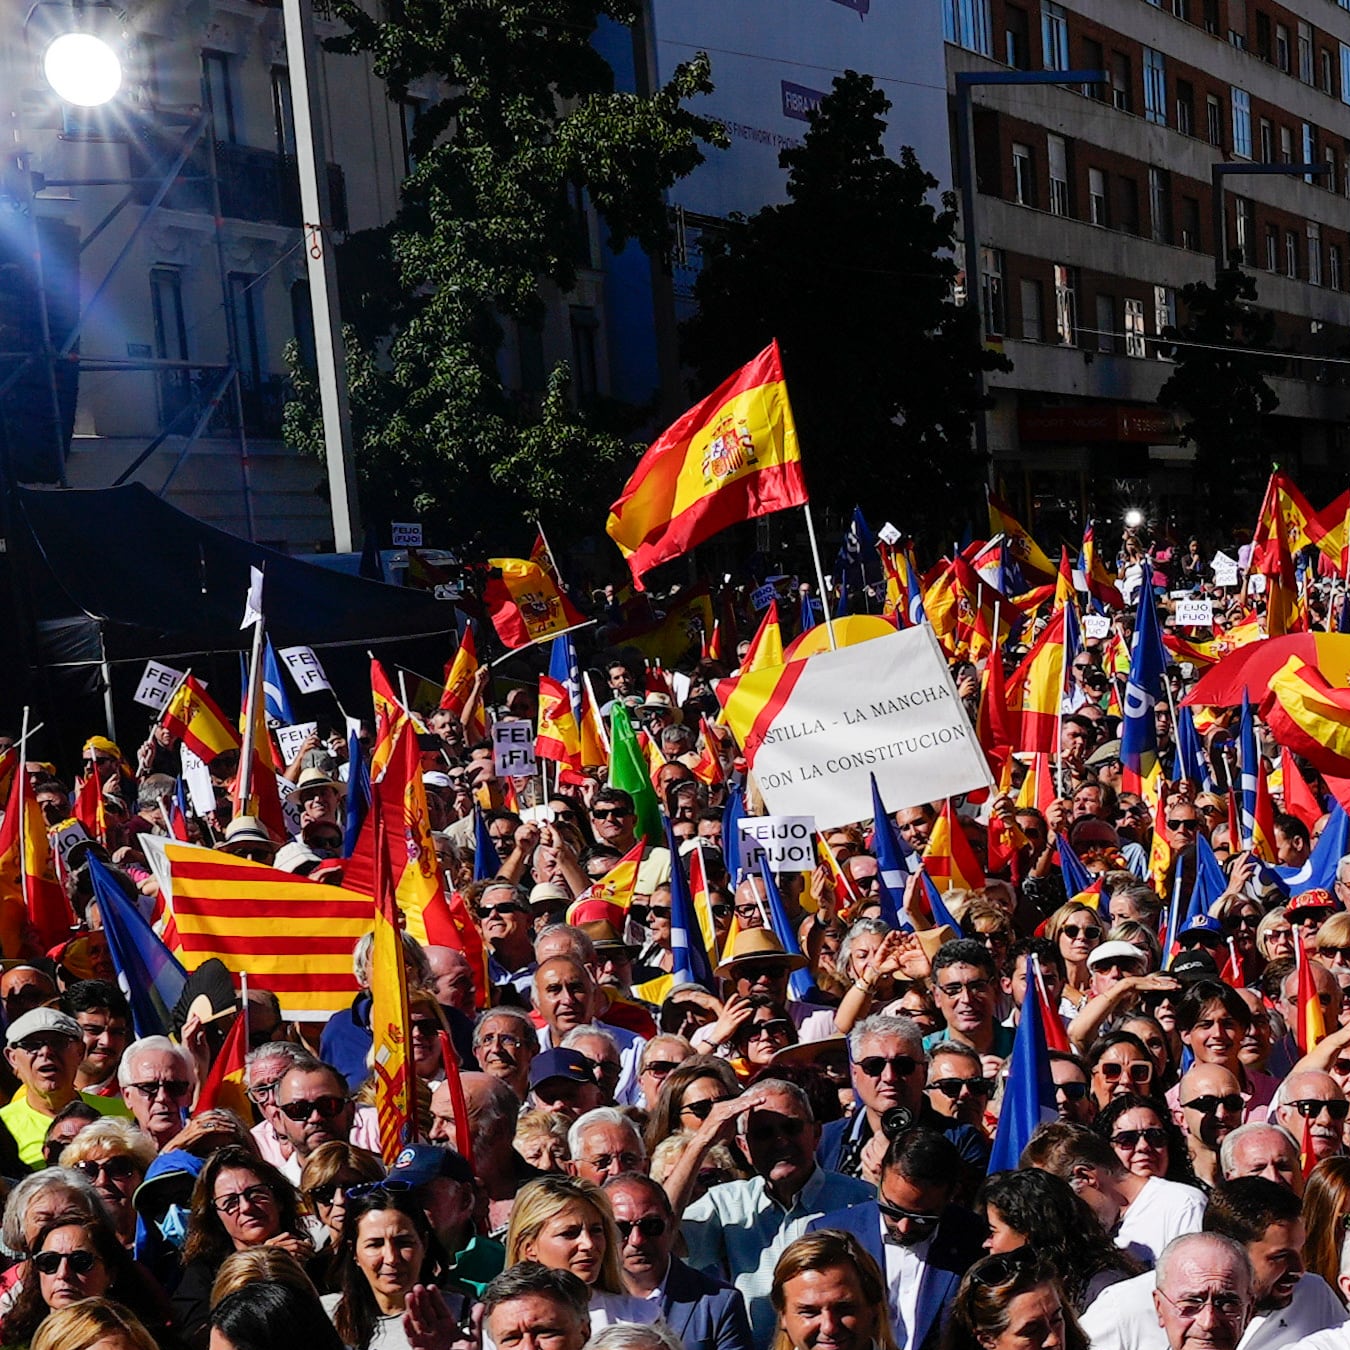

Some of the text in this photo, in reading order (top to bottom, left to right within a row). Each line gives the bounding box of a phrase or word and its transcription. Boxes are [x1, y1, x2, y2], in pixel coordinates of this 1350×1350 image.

[1177, 603, 1211, 613] FEIJO,
[287, 652, 318, 668] FEI
[843, 708, 867, 727] LA
[870, 684, 950, 718] MANCHA
[800, 762, 824, 781] LA
[747, 846, 812, 868] ¡FIJO!
